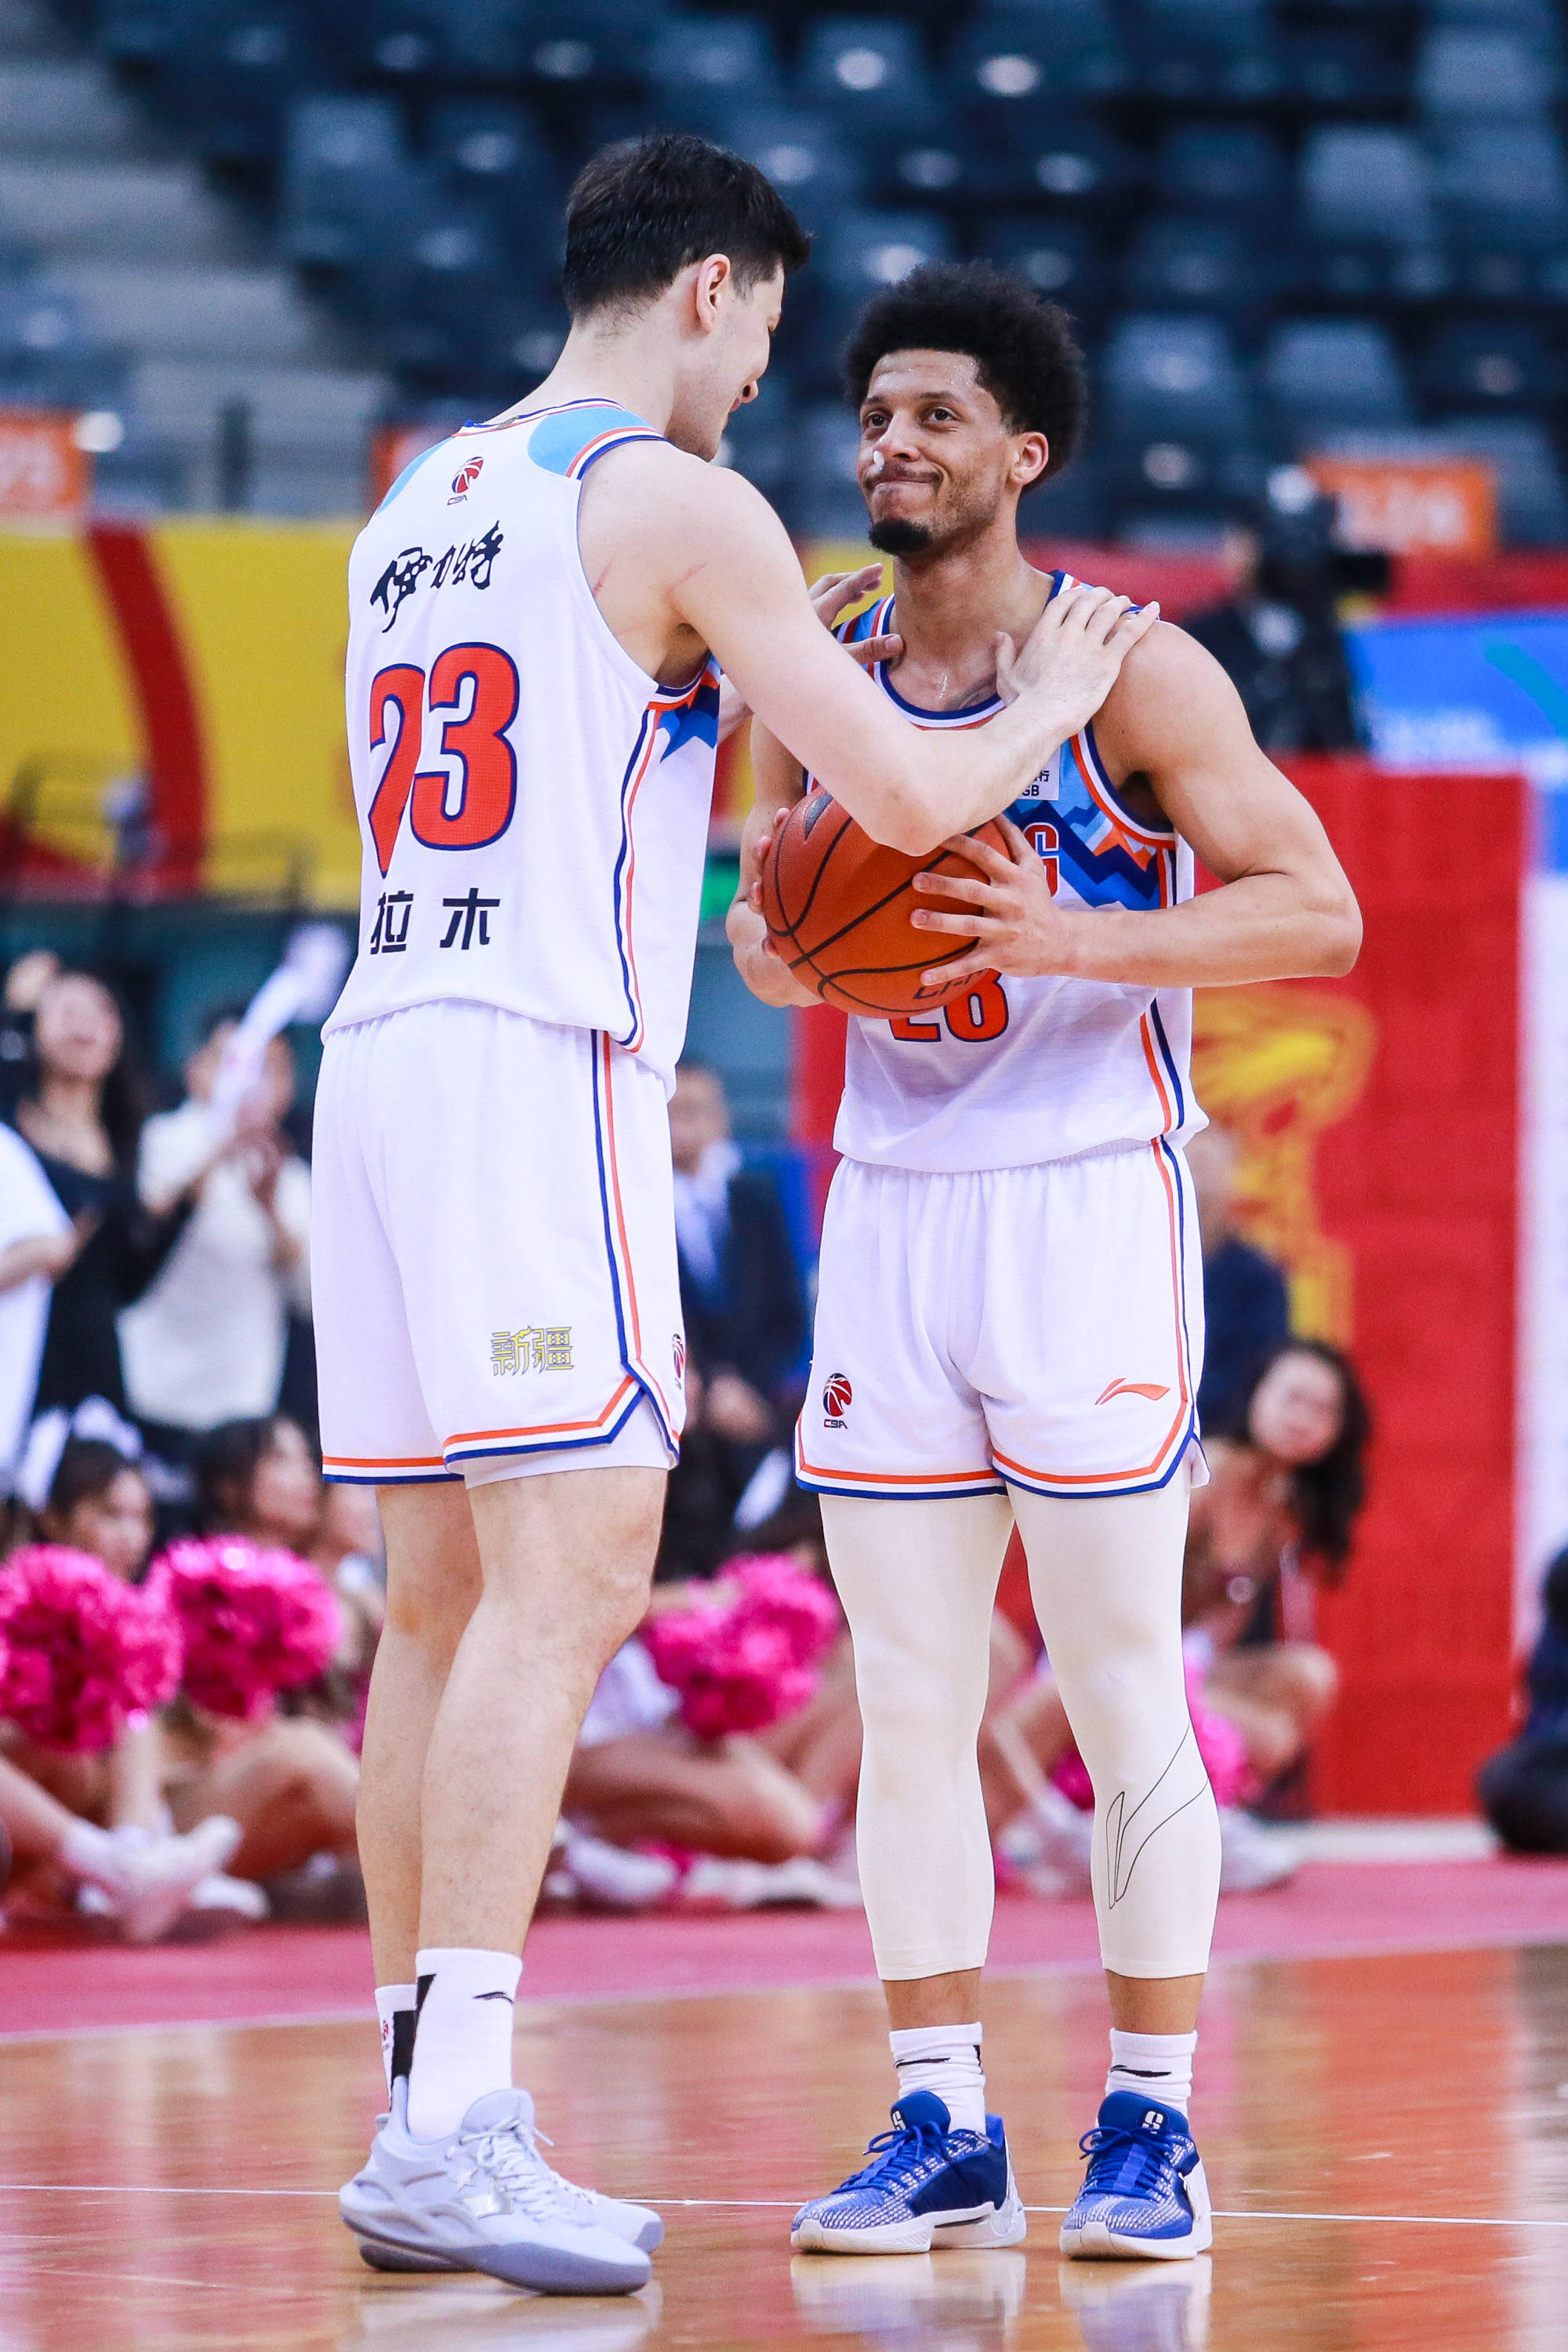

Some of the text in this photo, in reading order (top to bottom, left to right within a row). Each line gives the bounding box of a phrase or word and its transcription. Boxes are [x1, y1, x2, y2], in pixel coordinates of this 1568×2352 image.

[368, 642, 520, 879] 23
[490, 1325, 574, 1377] 新疆
[823, 1418, 848, 1429] CBA
